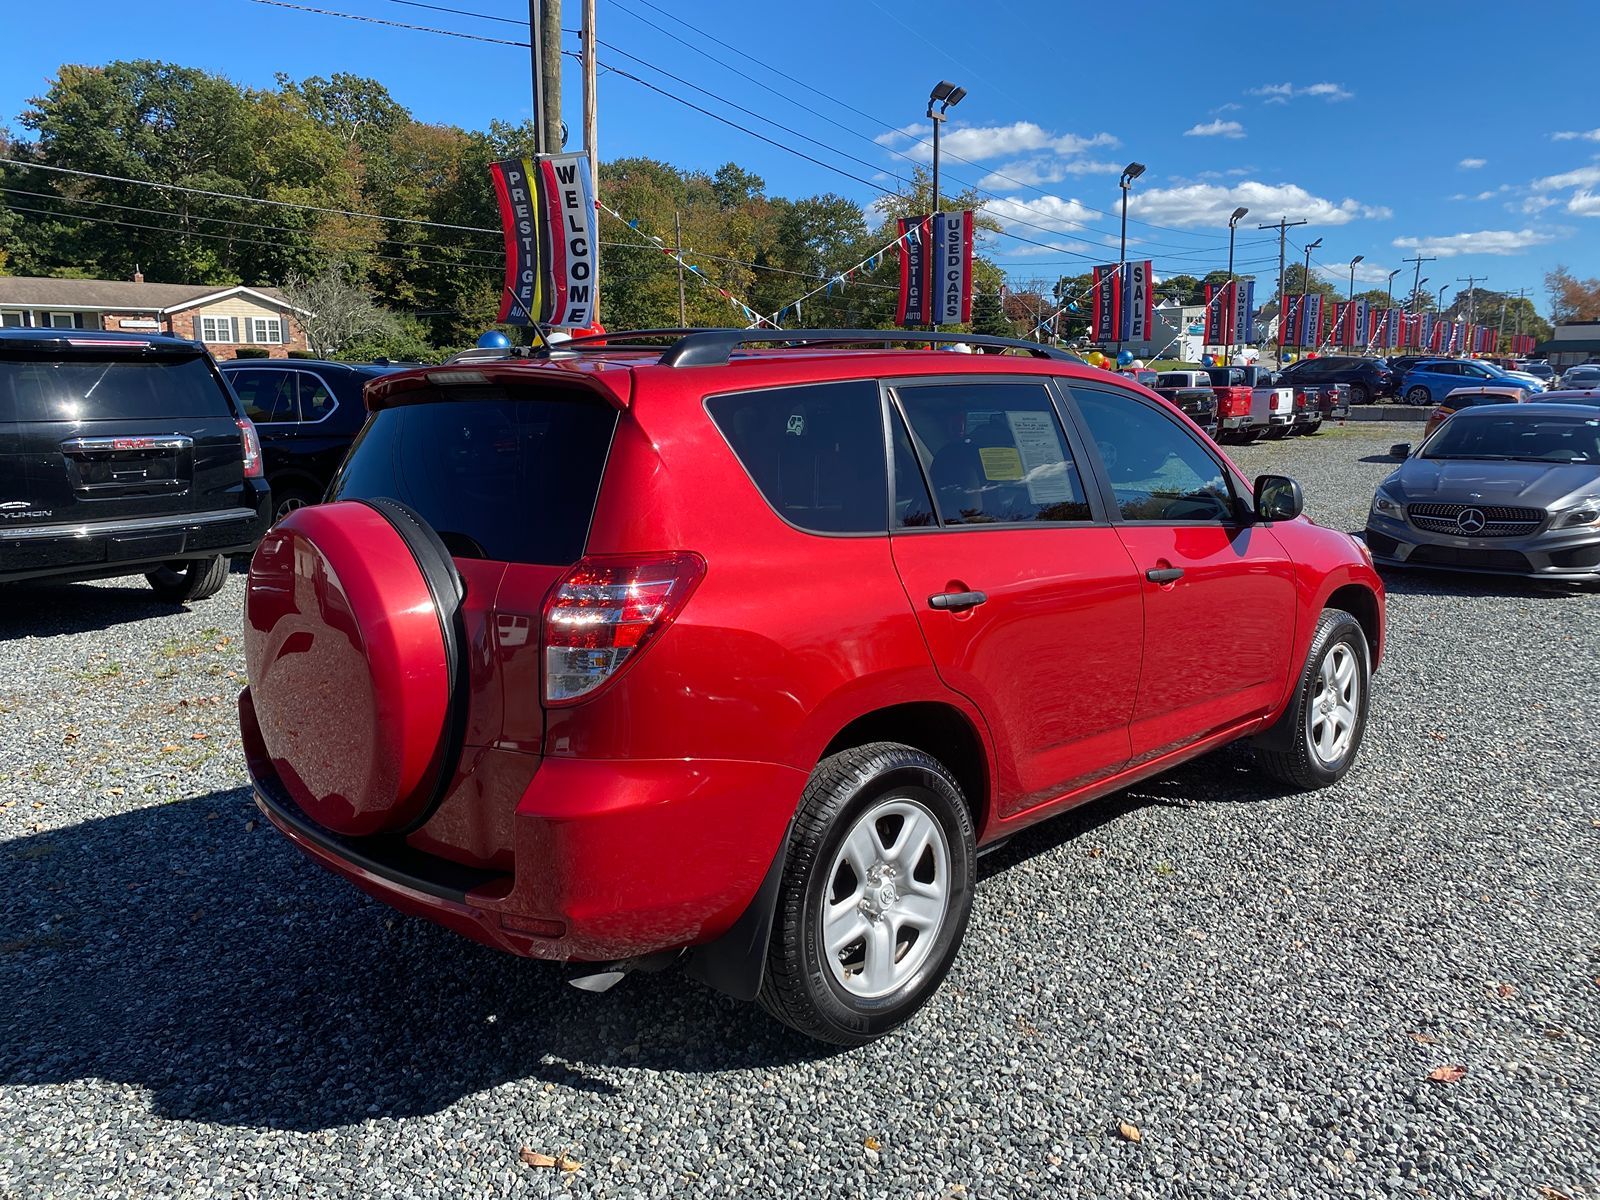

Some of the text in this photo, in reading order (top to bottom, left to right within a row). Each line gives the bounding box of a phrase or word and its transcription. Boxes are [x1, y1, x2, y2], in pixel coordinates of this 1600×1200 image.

[508, 171, 533, 299] PRESTIGE
[555, 164, 590, 323] WELCOME
[908, 223, 920, 307] PRESTIGE
[946, 219, 960, 317] USED CARS
[510, 304, 531, 318] AU
[905, 312, 921, 320] AUTO
[1100, 269, 1111, 330] PRESTIGE
[1133, 266, 1144, 337] SALE
[1236, 286, 1246, 341] LOW PRICES
[1286, 297, 1296, 337] PRTIGE
[0, 510, 52, 519] YUKON
